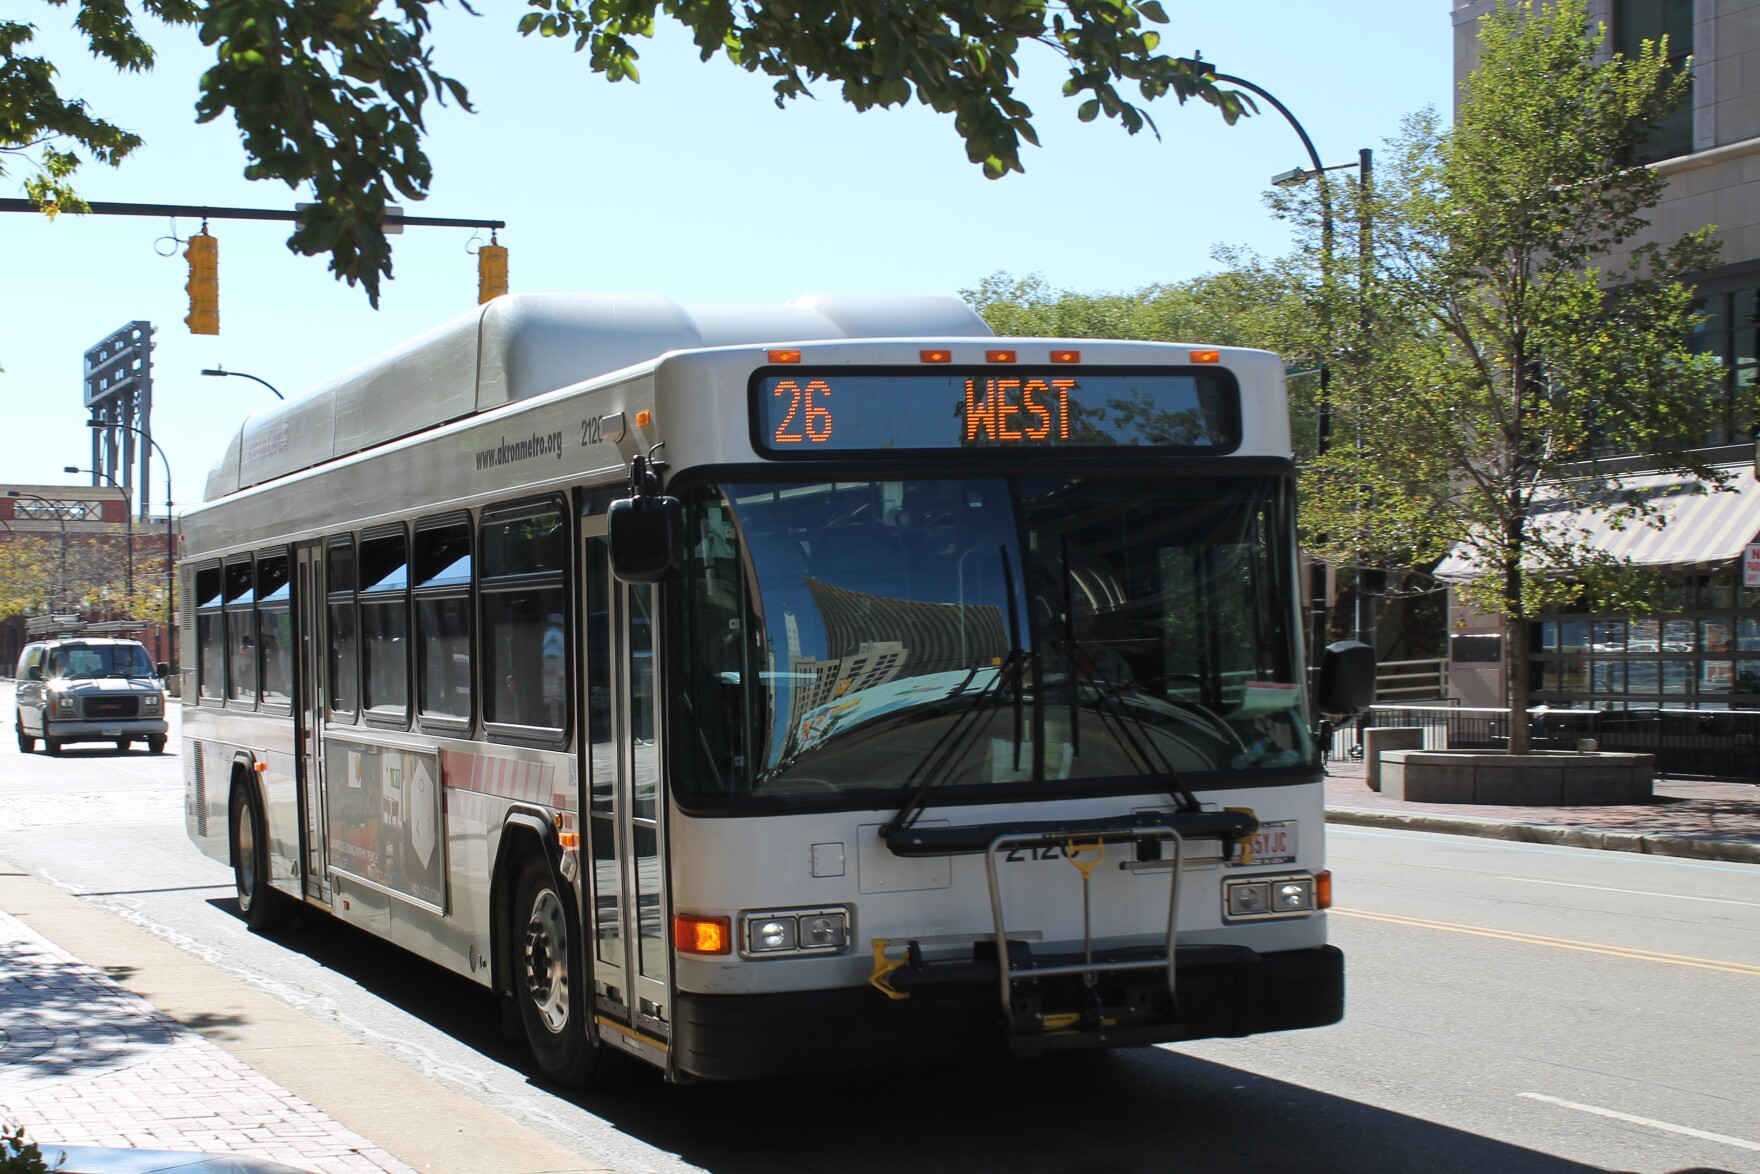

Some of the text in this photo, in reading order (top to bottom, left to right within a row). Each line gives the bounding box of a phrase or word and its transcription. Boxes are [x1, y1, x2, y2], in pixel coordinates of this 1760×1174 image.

[774, 379, 1075, 442] 26 WEST
[475, 431, 563, 470] www.akronmetro.org
